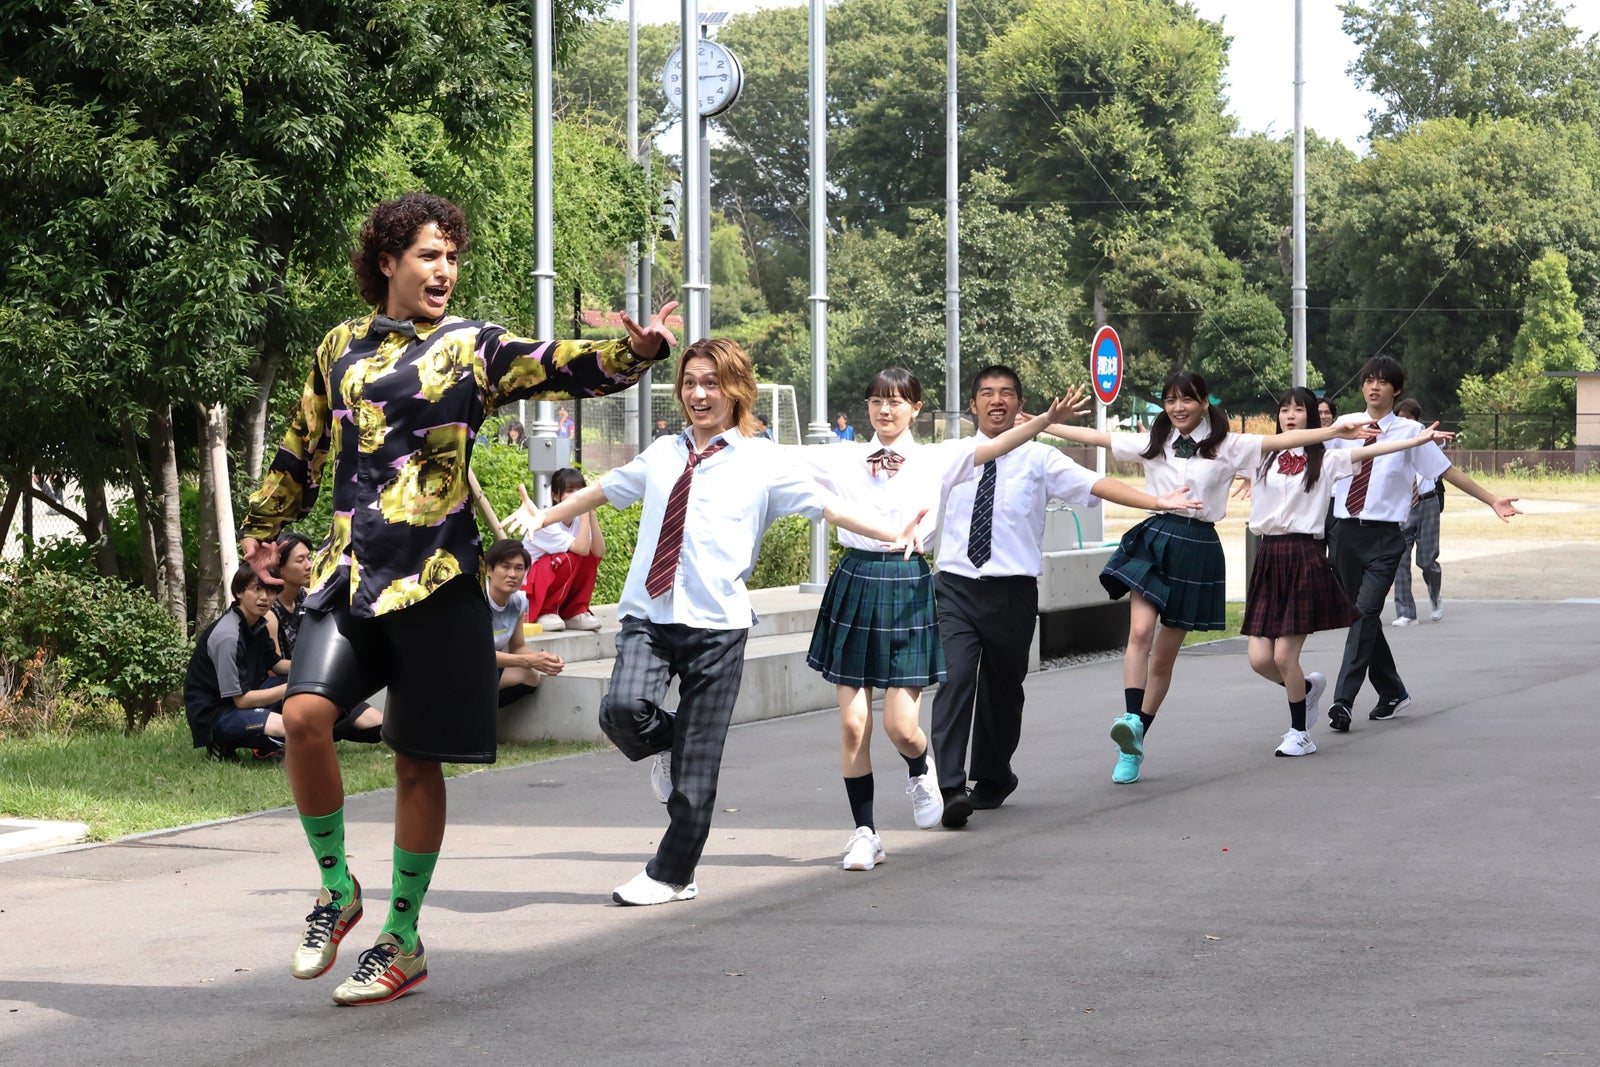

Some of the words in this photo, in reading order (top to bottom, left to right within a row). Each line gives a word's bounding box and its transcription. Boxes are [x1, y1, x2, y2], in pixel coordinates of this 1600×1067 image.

[717, 60, 724, 68] 2
[670, 74, 678, 82] 9
[720, 74, 728, 82] 3
[716, 86, 724, 94] 4
[707, 96, 714, 104] 5
